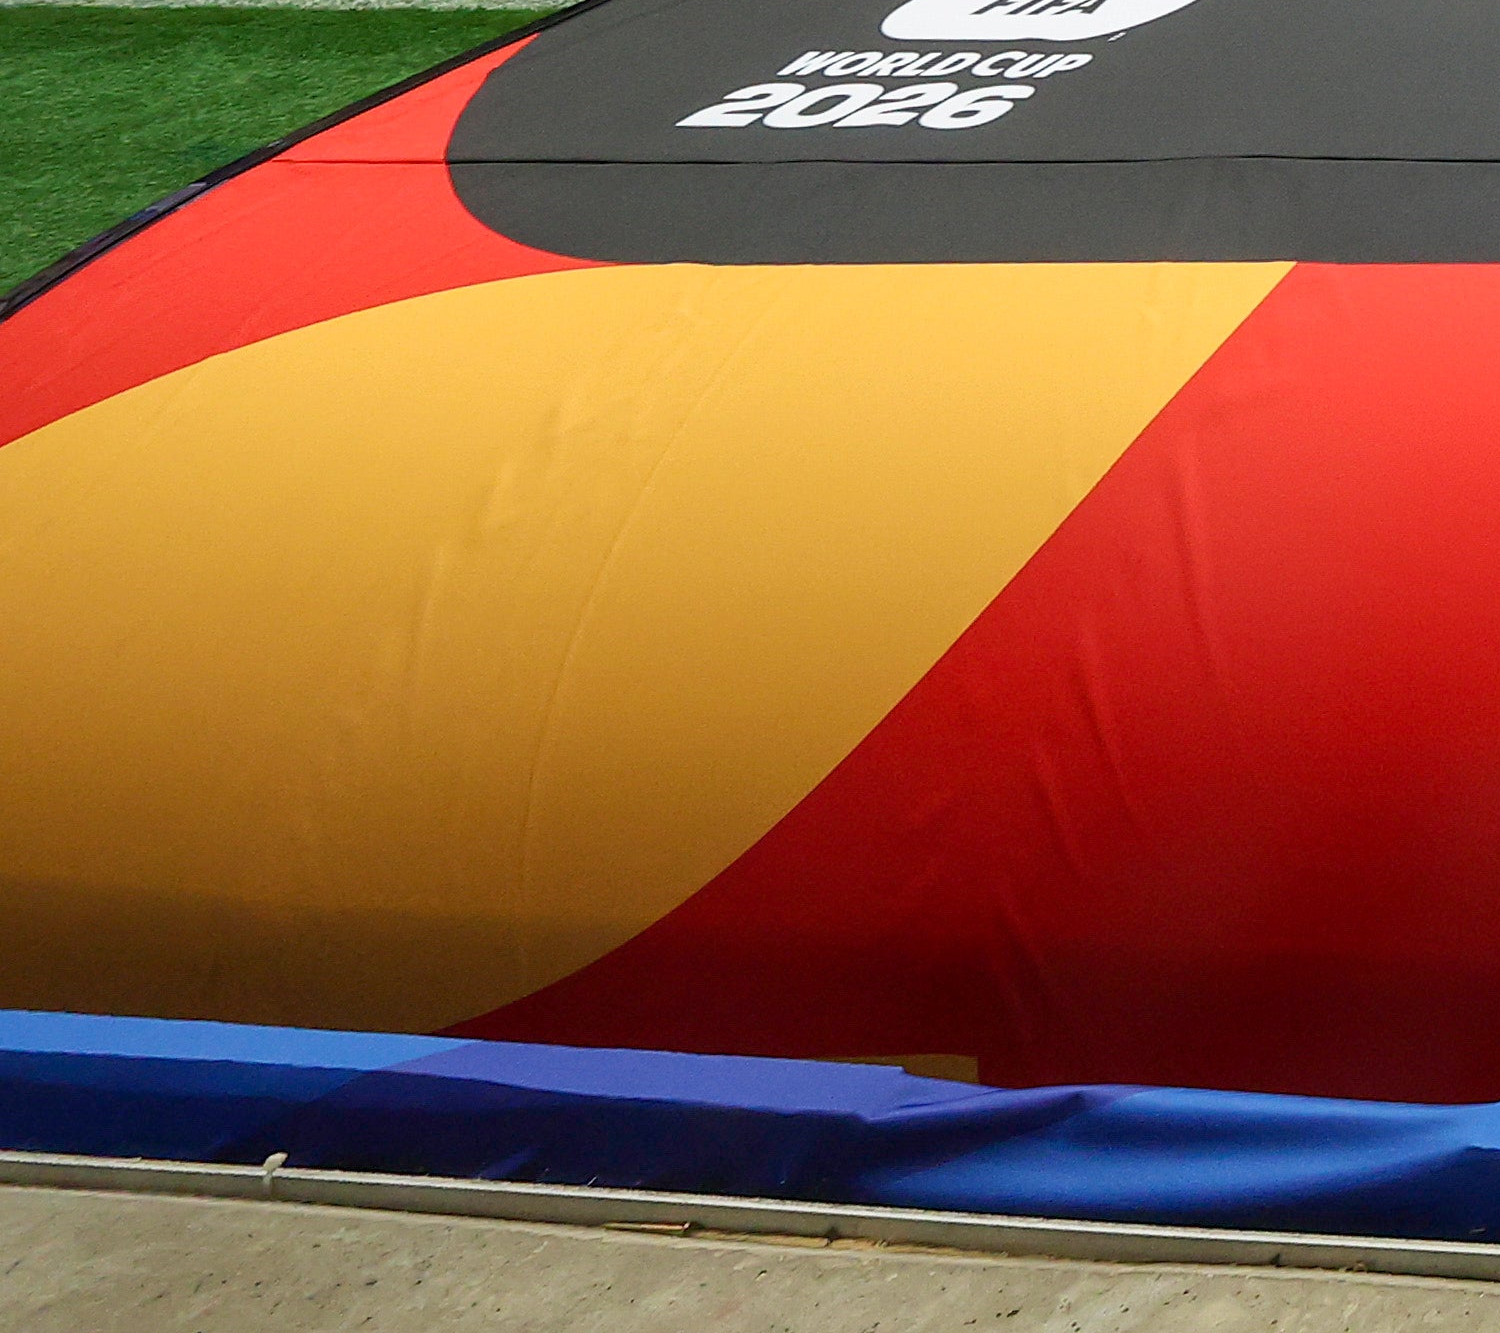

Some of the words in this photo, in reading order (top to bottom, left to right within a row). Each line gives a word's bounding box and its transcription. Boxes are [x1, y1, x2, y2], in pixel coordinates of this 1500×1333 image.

[777, 51, 982, 77] WORLD
[972, 51, 1094, 78] CUP
[675, 82, 1036, 129] 2026
